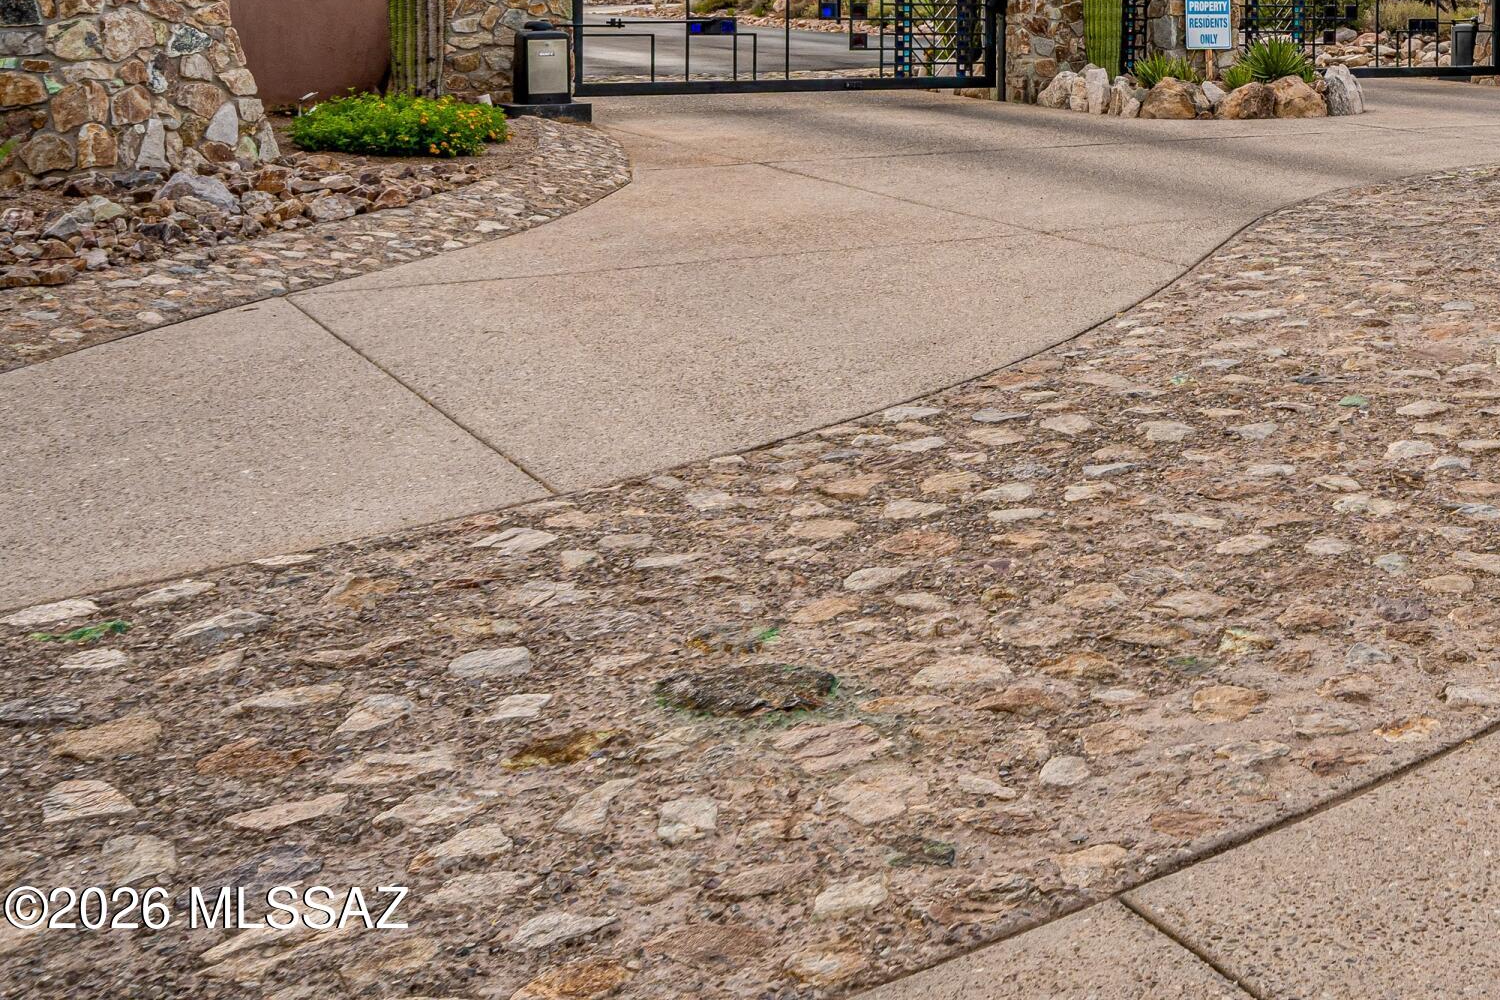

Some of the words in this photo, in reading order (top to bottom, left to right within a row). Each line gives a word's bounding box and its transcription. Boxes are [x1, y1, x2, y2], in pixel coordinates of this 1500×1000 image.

[1188, 1, 1228, 12] PROPERTY
[1189, 17, 1228, 28] RESIDENTS
[1200, 33, 1218, 45] ONLY
